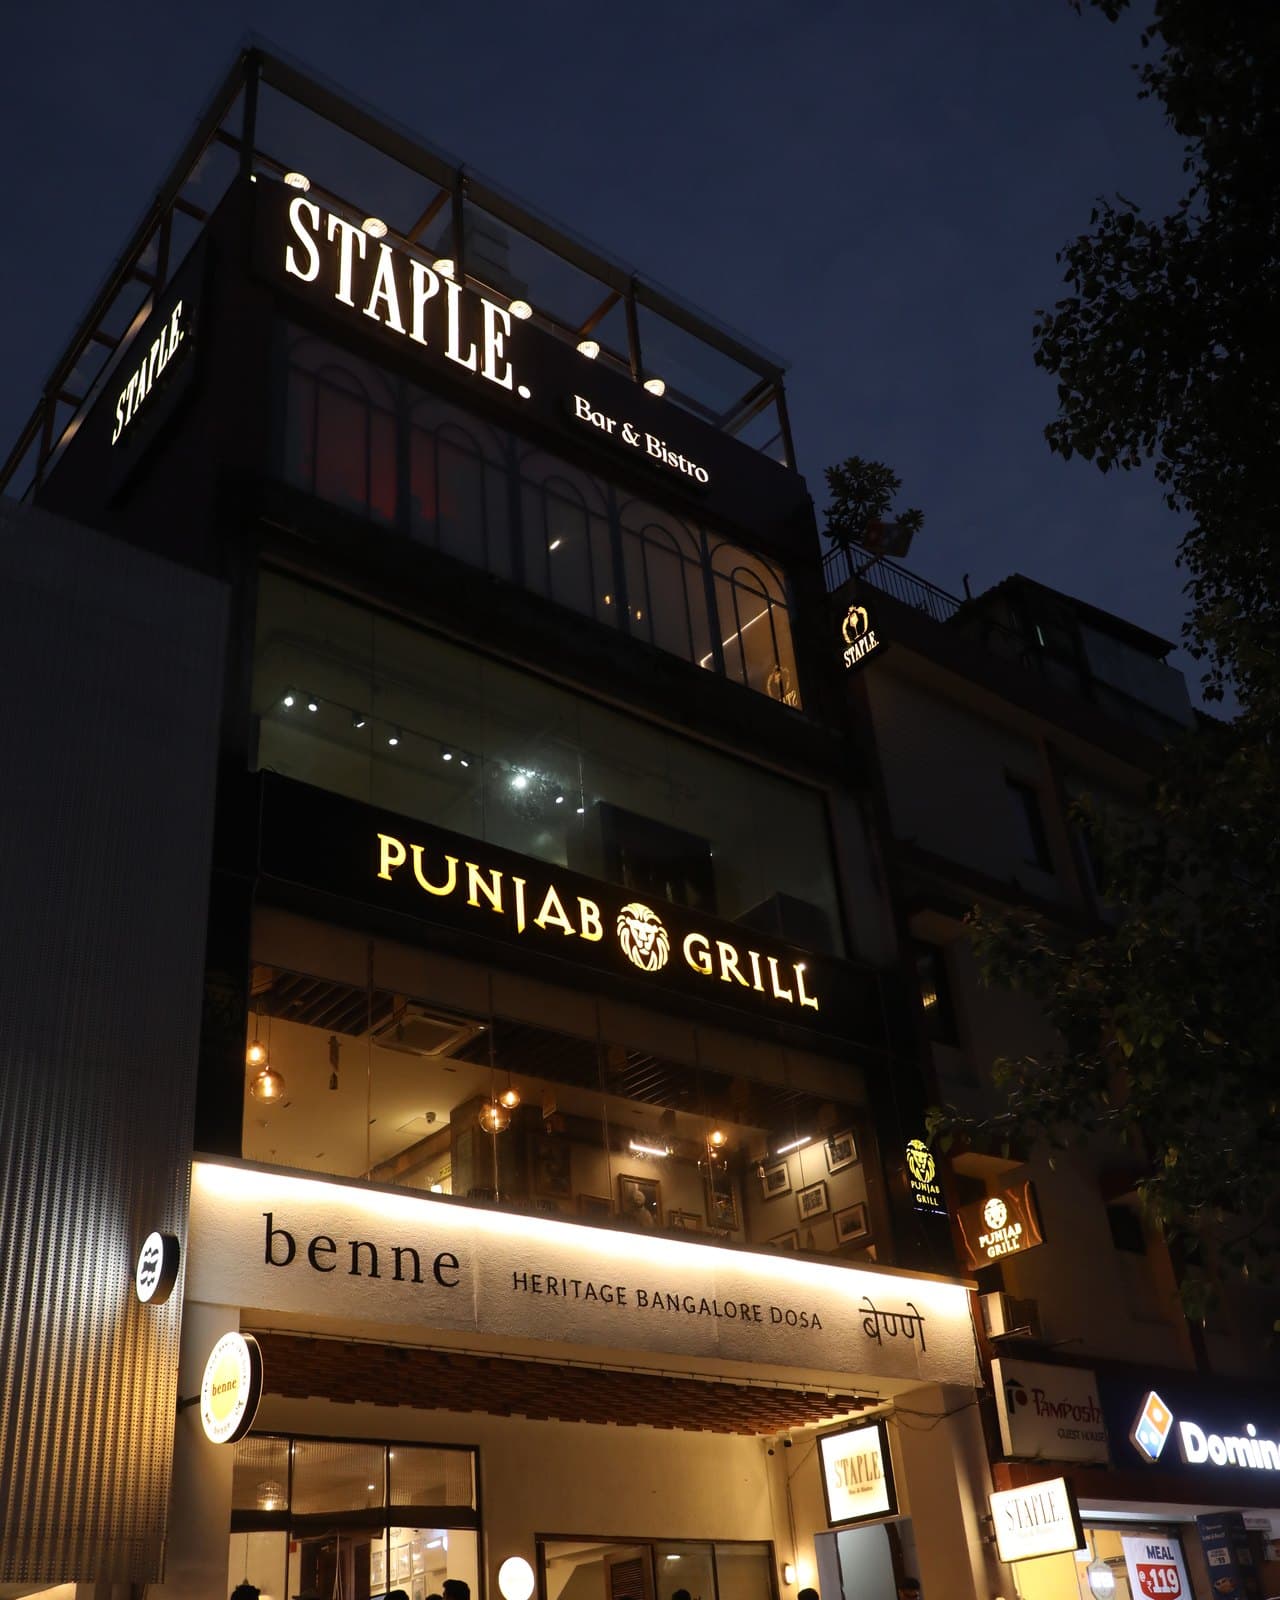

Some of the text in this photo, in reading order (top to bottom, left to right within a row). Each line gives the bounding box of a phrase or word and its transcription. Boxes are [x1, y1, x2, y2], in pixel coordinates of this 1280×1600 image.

[284, 197, 532, 399] STAPLE.
[574, 394, 709, 483] Bar & Bistro
[377, 833, 819, 1011] PUNJAB GRILL
[910, 1180, 941, 1194] PUNJAB
[916, 1193, 940, 1206] GRILL
[262, 1212, 461, 1288] benne
[978, 1223, 1023, 1249] PUNJAB
[987, 1236, 1020, 1258] GRILL
[512, 1271, 824, 1330] HERITAGE BANGALORE DOSA
[211, 1379, 238, 1397] benne
[1178, 1421, 1280, 1471] Domin
[1146, 1545, 1175, 1560] MEAL
